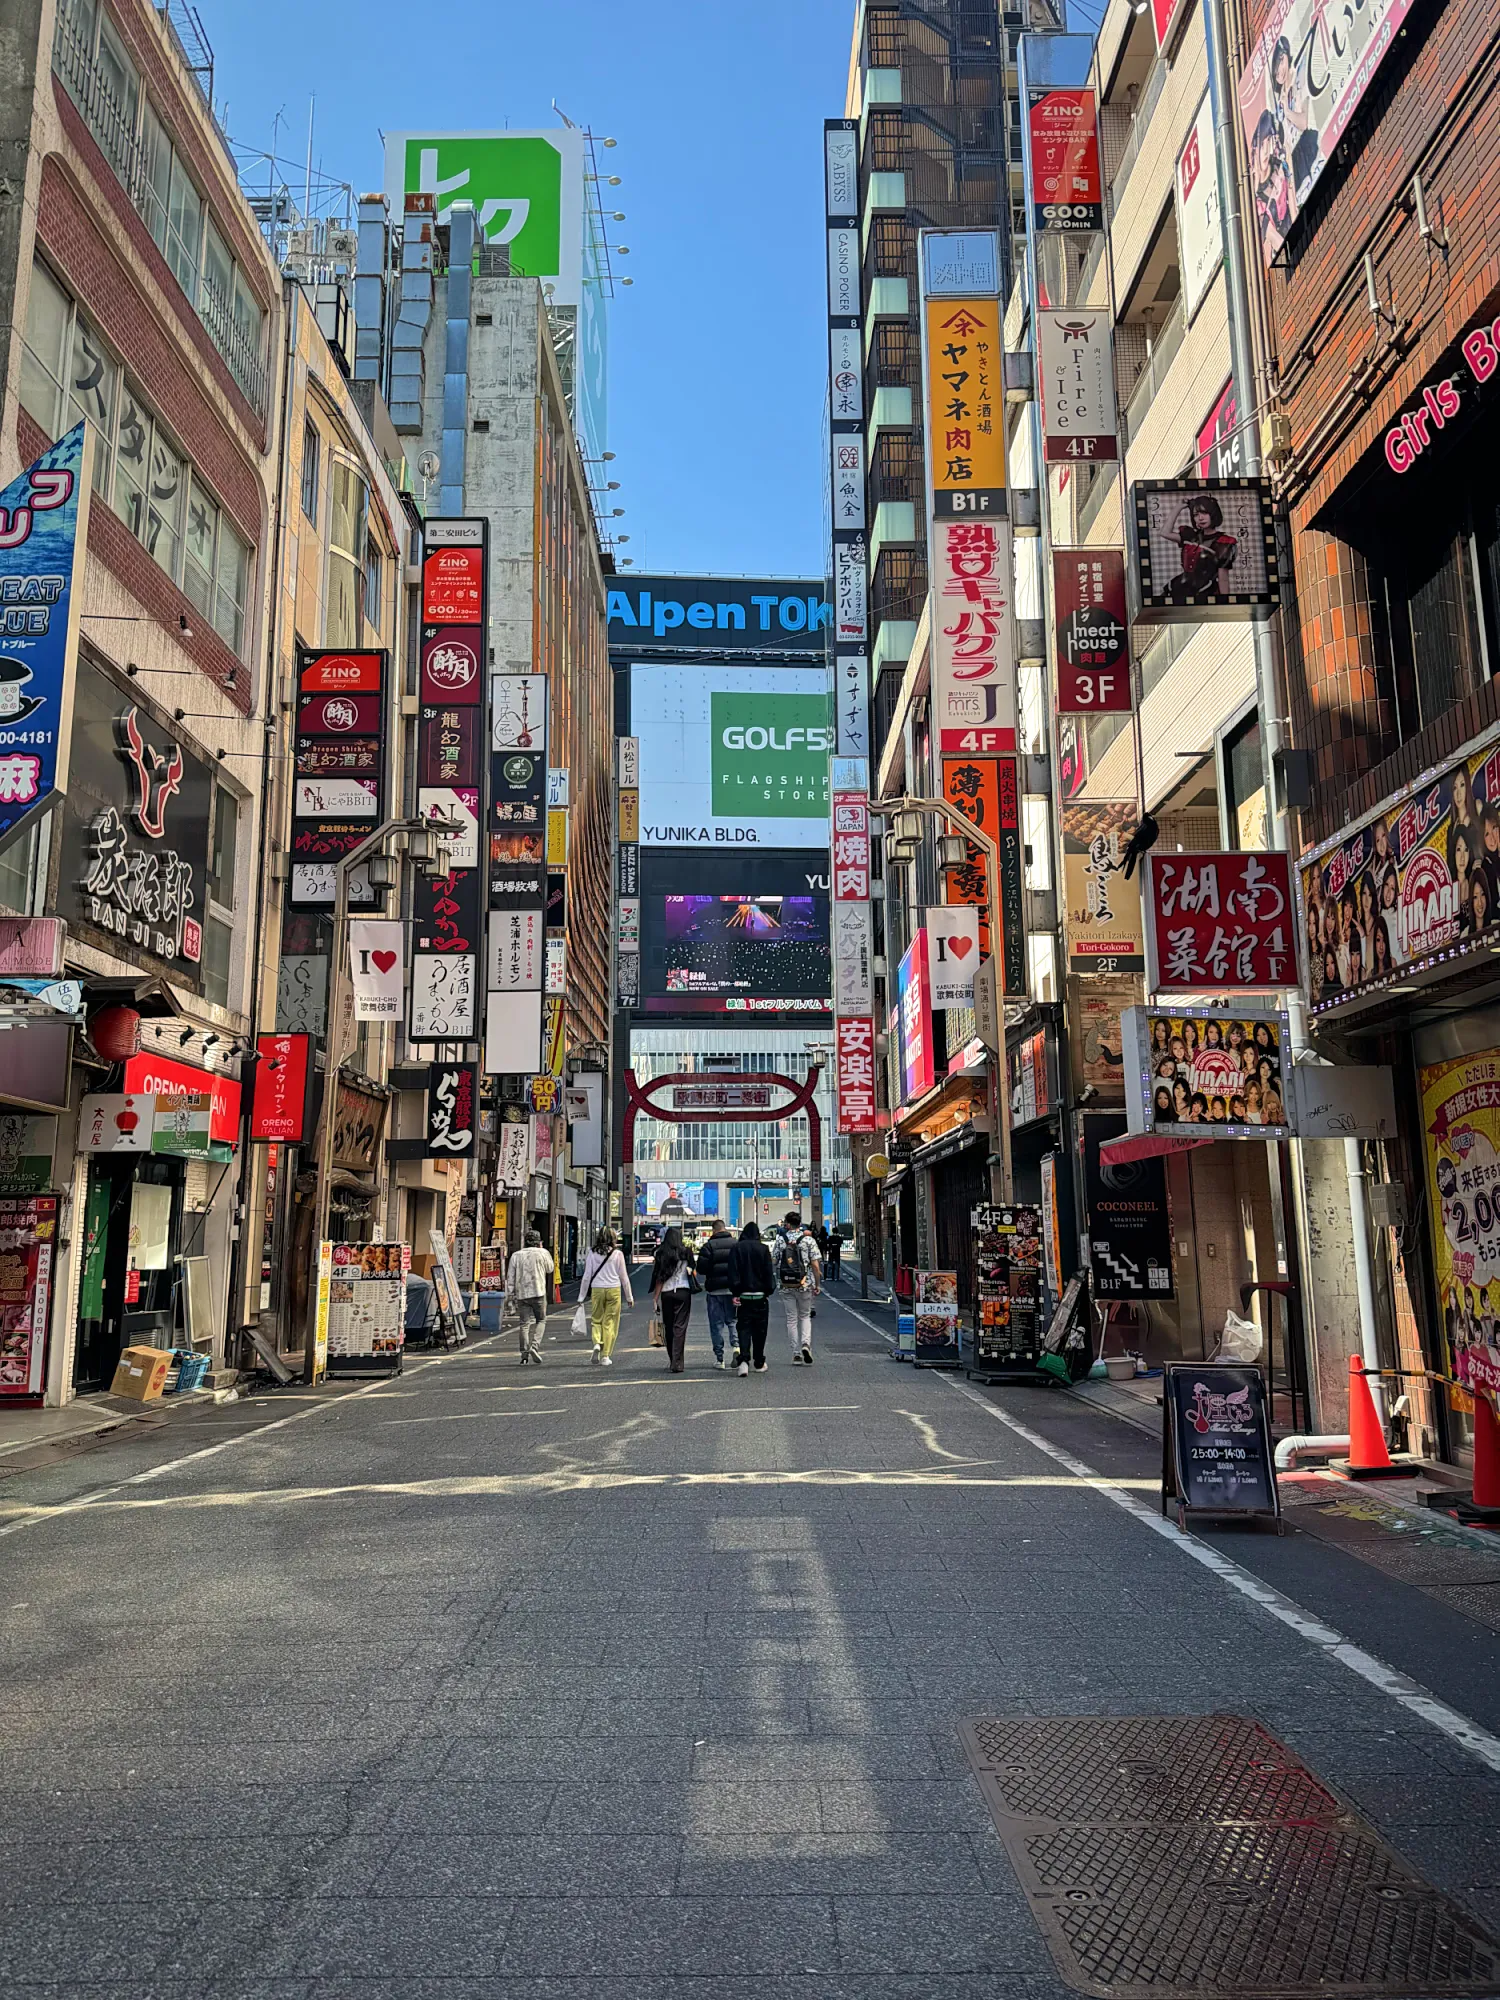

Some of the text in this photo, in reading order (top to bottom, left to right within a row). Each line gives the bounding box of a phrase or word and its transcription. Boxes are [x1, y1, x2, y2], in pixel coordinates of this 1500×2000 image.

[1042, 106, 1084, 116] ZINO
[842, 121, 852, 130] 10
[833, 162, 846, 203] ABYSS
[1042, 205, 1088, 220] 600
[848, 219, 855, 228] 9
[837, 233, 850, 312] CASINO POKER
[850, 319, 858, 329] 8
[976, 341, 993, 436] やきとん酒場
[1072, 348, 1088, 418] Fire
[1057, 379, 1069, 428] Ice
[941, 342, 974, 482] ヤマネ肉店
[852, 423, 860, 433] 7
[1385, 379, 1461, 474] Girls
[1065, 437, 1097, 457] 4F
[840, 482, 861, 517] 魚金
[952, 492, 989, 512] B1F
[856, 533, 863, 543] 6
[438, 559, 469, 567] ZINO
[428, 605, 455, 614] 600
[941, 524, 1007, 681] 熟女キャバクラ
[606, 589, 747, 637] Alpen
[1072, 609, 1125, 640] meat
[424, 628, 437, 638] 4F
[858, 645, 865, 656] 5
[1067, 631, 1119, 664] house
[320, 667, 362, 678] ZINO
[1075, 675, 1115, 704] 3F
[301, 697, 312, 705] 4F
[964, 683, 1008, 725] J
[423, 708, 437, 719] 3F
[845, 682, 862, 750] すずや
[300, 738, 312, 748] 3F
[440, 712, 461, 780] 龍幻酒家
[722, 726, 827, 751] GOLF5
[959, 731, 997, 752] 4F
[624, 740, 635, 784] 小松ビル
[363, 779, 378, 791] 2F
[722, 774, 829, 786] FLAGSHIP
[461, 792, 479, 807] 2F
[763, 790, 829, 800] STORE
[642, 826, 761, 843] YUNIKA BLDG.
[838, 823, 864, 831] JAPAN
[628, 846, 636, 894] BUZZ STAND
[835, 835, 868, 897] 焼肉
[1159, 855, 1285, 924] 湖南
[1068, 931, 1144, 942] Yakitori Izakaya
[509, 914, 522, 984] 芝浦ホルモン
[1080, 942, 1130, 952] Tori-Gokoro
[1096, 957, 1118, 972] 2F
[448, 955, 471, 1018] 居酒屋
[620, 995, 636, 1006] 7F
[936, 990, 974, 1001] 歌舞伎町
[360, 1002, 397, 1013] 歌舞伎町
[748, 998, 822, 1010] 1stフルアルバム
[415, 1006, 426, 1035] 一番街
[274, 1040, 292, 1114] 俺のイタリアン
[839, 1020, 874, 1122] 安楽亭
[1464, 1063, 1496, 1083] ただいま
[532, 1079, 556, 1094] 50
[536, 1098, 552, 1112] 円
[676, 1090, 768, 1105] 歌舞伎町一番街
[91, 1107, 105, 1146] 大原屋
[261, 1118, 295, 1127] ORENO
[733, 1166, 784, 1180] Alpen
[1096, 1201, 1159, 1212] COCONEEL
[981, 1209, 1001, 1225] 4F
[332, 1267, 348, 1277] 4F
[1099, 1278, 1122, 1290] B1F
